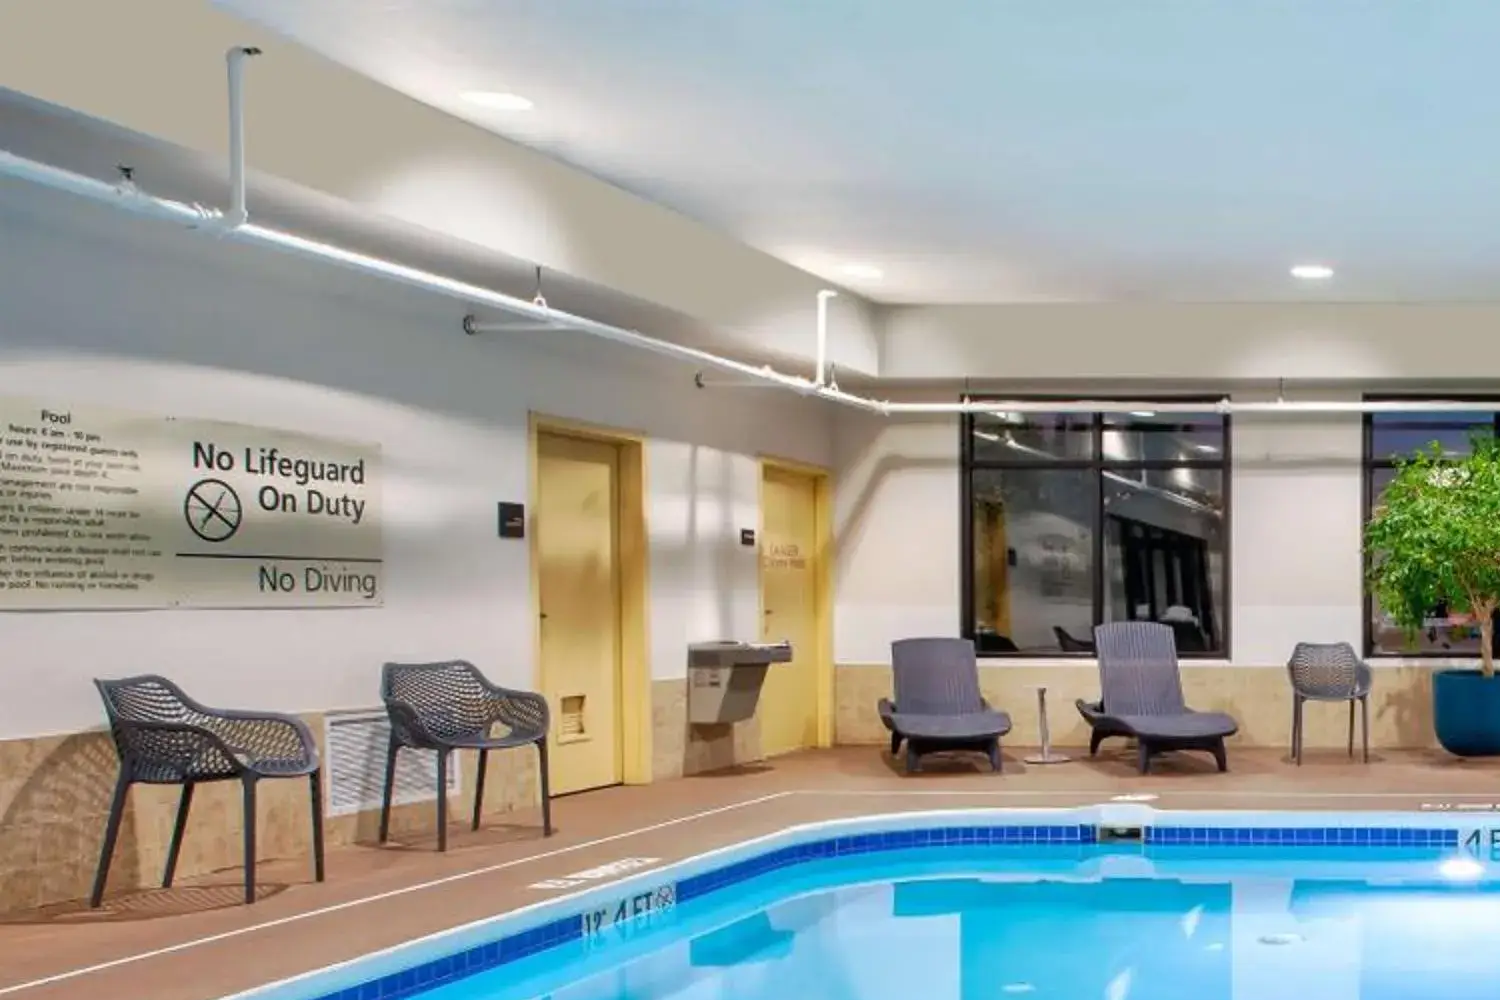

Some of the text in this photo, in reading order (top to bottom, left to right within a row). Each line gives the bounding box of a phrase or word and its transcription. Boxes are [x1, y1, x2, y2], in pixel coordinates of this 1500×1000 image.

[41, 409, 71, 424] Pool
[41, 441, 87, 453] registered
[193, 441, 365, 486] No Lifeguard
[258, 485, 365, 525] On Duty
[258, 566, 378, 600] No Diving
